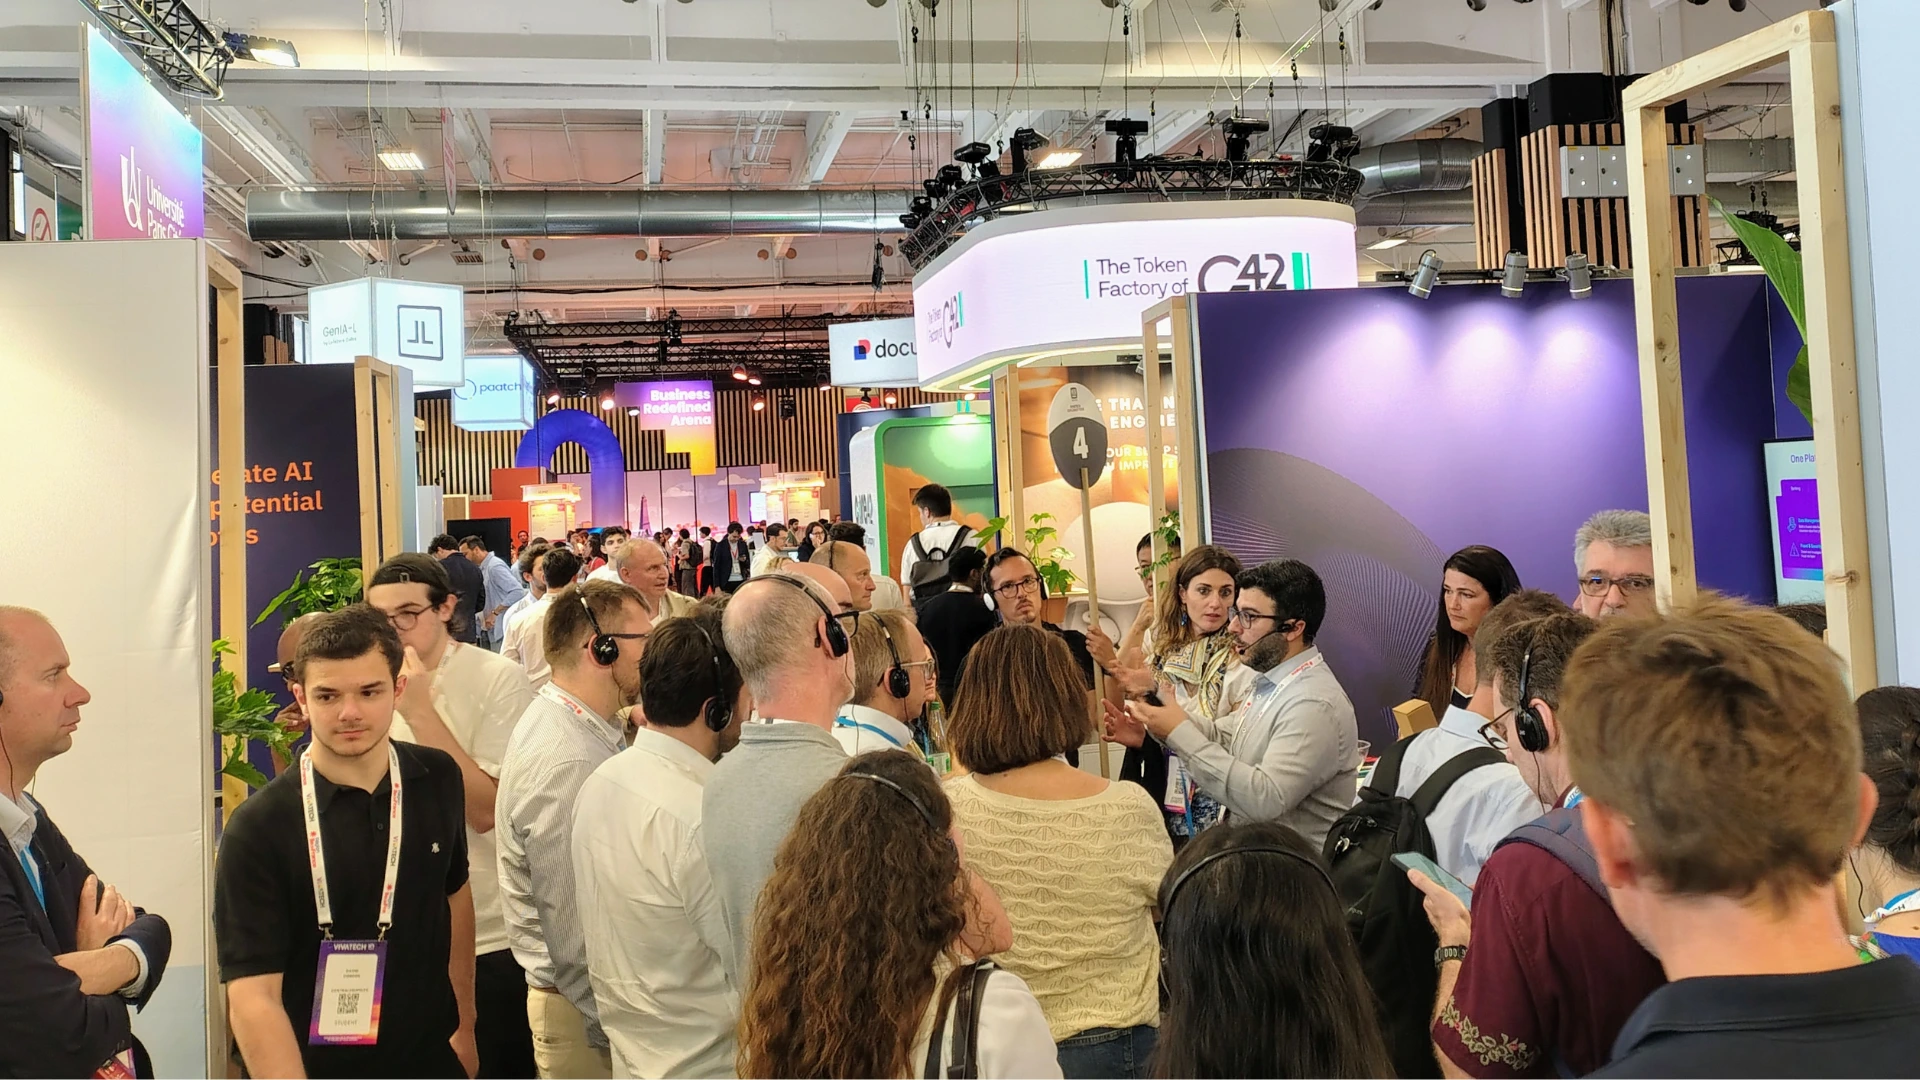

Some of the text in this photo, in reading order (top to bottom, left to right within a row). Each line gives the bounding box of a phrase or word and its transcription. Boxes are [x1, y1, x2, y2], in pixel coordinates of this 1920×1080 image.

[147, 175, 184, 227] Université
[1096, 257, 1187, 275] The Token
[1098, 278, 1189, 299] Factory of
[322, 323, 357, 337] GenIA-L
[875, 338, 917, 358] docu
[480, 382, 521, 395] paatch
[650, 388, 711, 401] Business
[643, 401, 711, 414] Redefined
[1108, 398, 1144, 411] THA
[670, 415, 712, 426] Arena
[1073, 427, 1089, 459] 4
[1106, 447, 1131, 458] OUR
[1790, 454, 1816, 463] One Pla
[284, 461, 313, 481] AI
[210, 490, 323, 520] ptential
